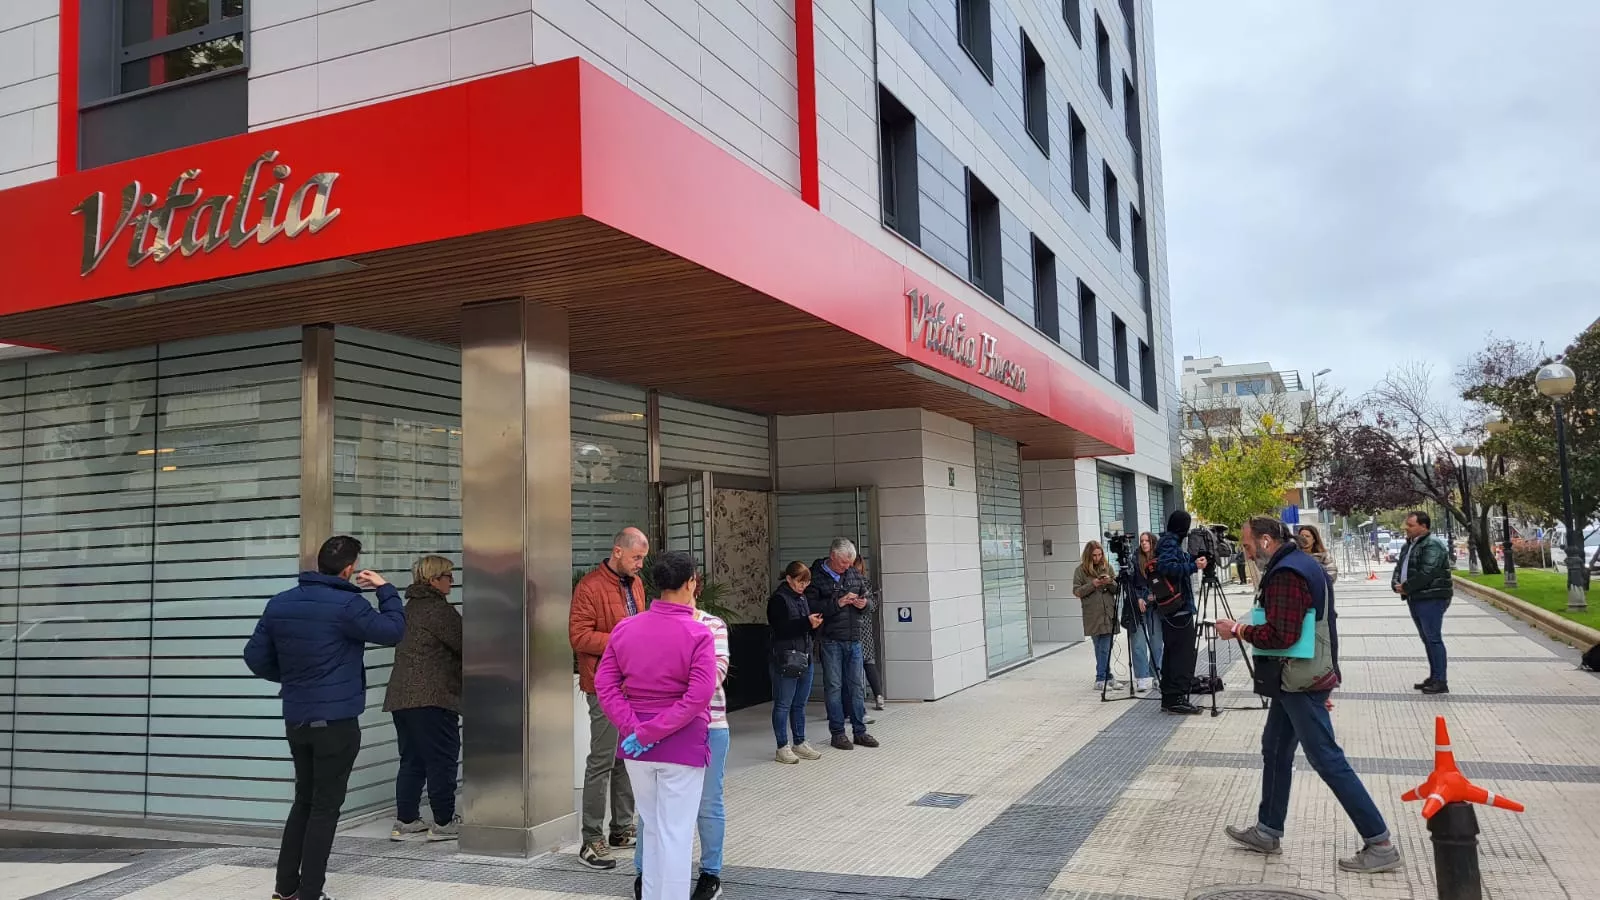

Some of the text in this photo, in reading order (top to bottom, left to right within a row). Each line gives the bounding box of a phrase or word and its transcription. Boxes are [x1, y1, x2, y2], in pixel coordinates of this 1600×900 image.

[71, 150, 341, 277] Vitalia
[905, 288, 1027, 392] Vitalia Huesca
